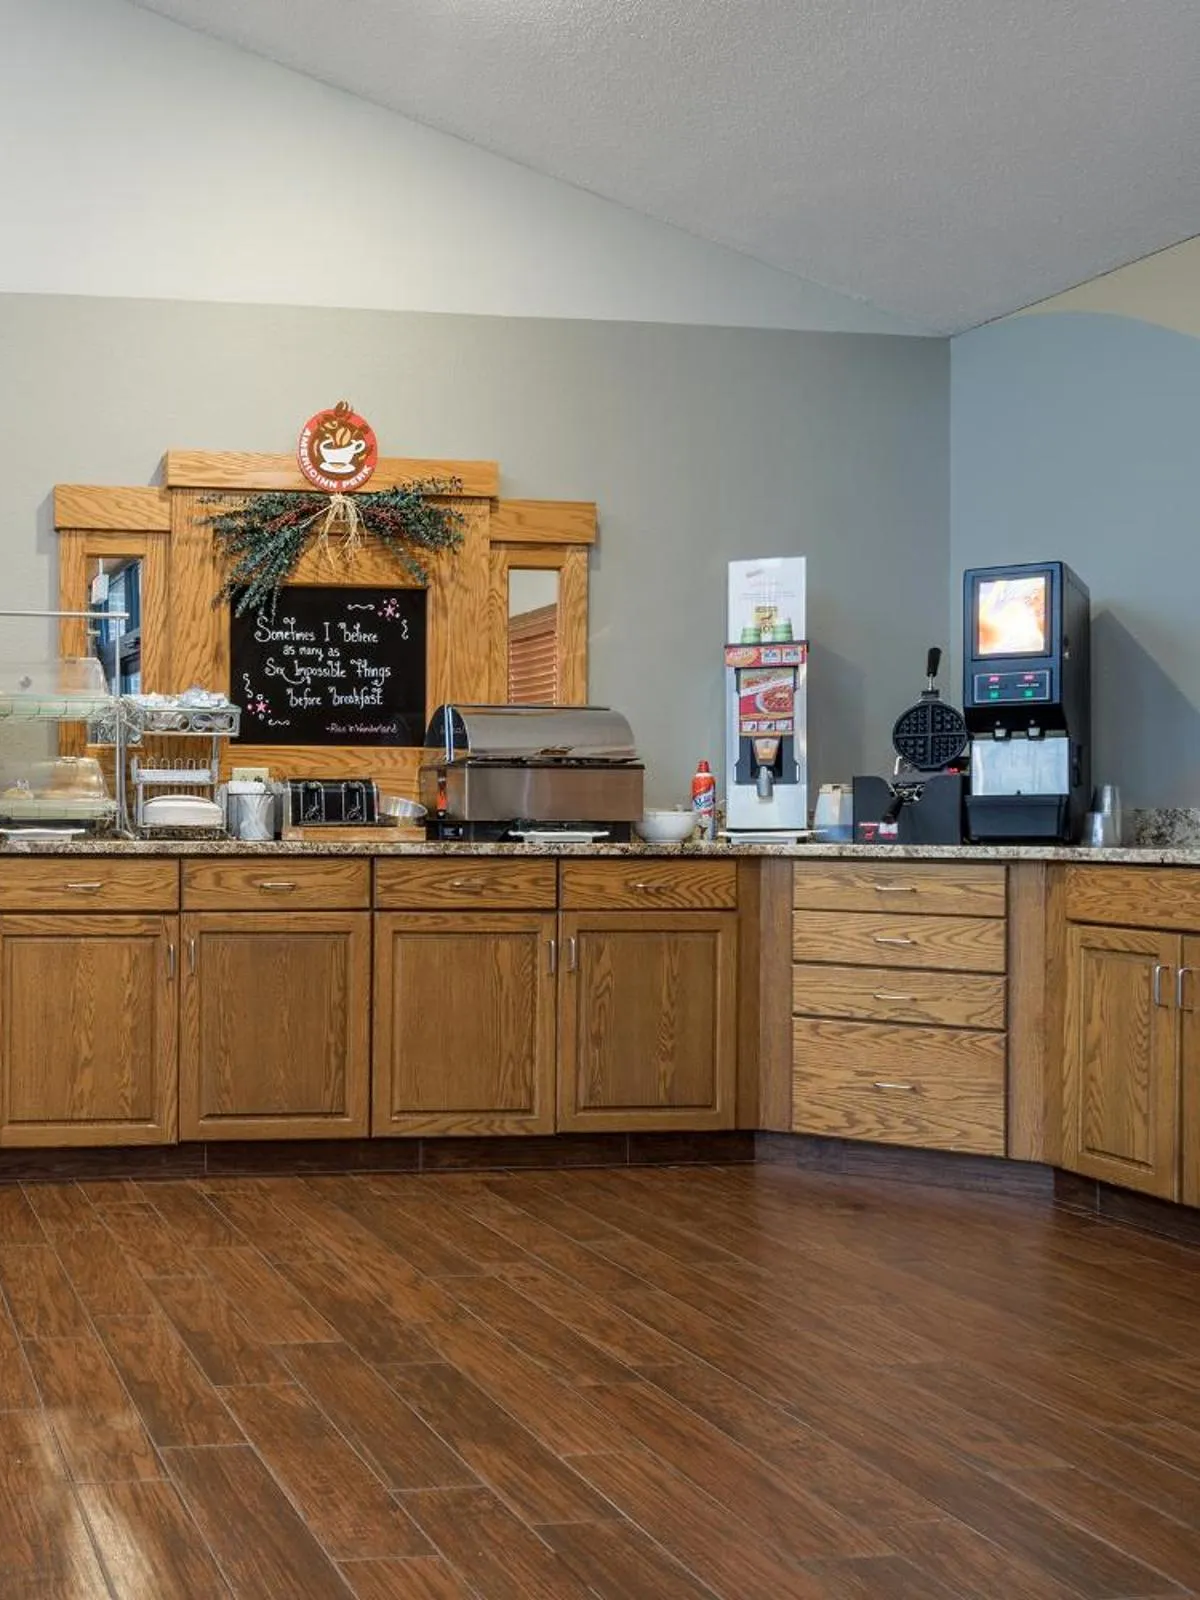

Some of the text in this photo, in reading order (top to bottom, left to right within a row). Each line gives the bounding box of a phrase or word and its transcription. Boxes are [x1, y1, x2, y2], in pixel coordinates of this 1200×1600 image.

[254, 615, 316, 642] Sometimes
[323, 622, 331, 642] I
[283, 645, 340, 661] as many as
